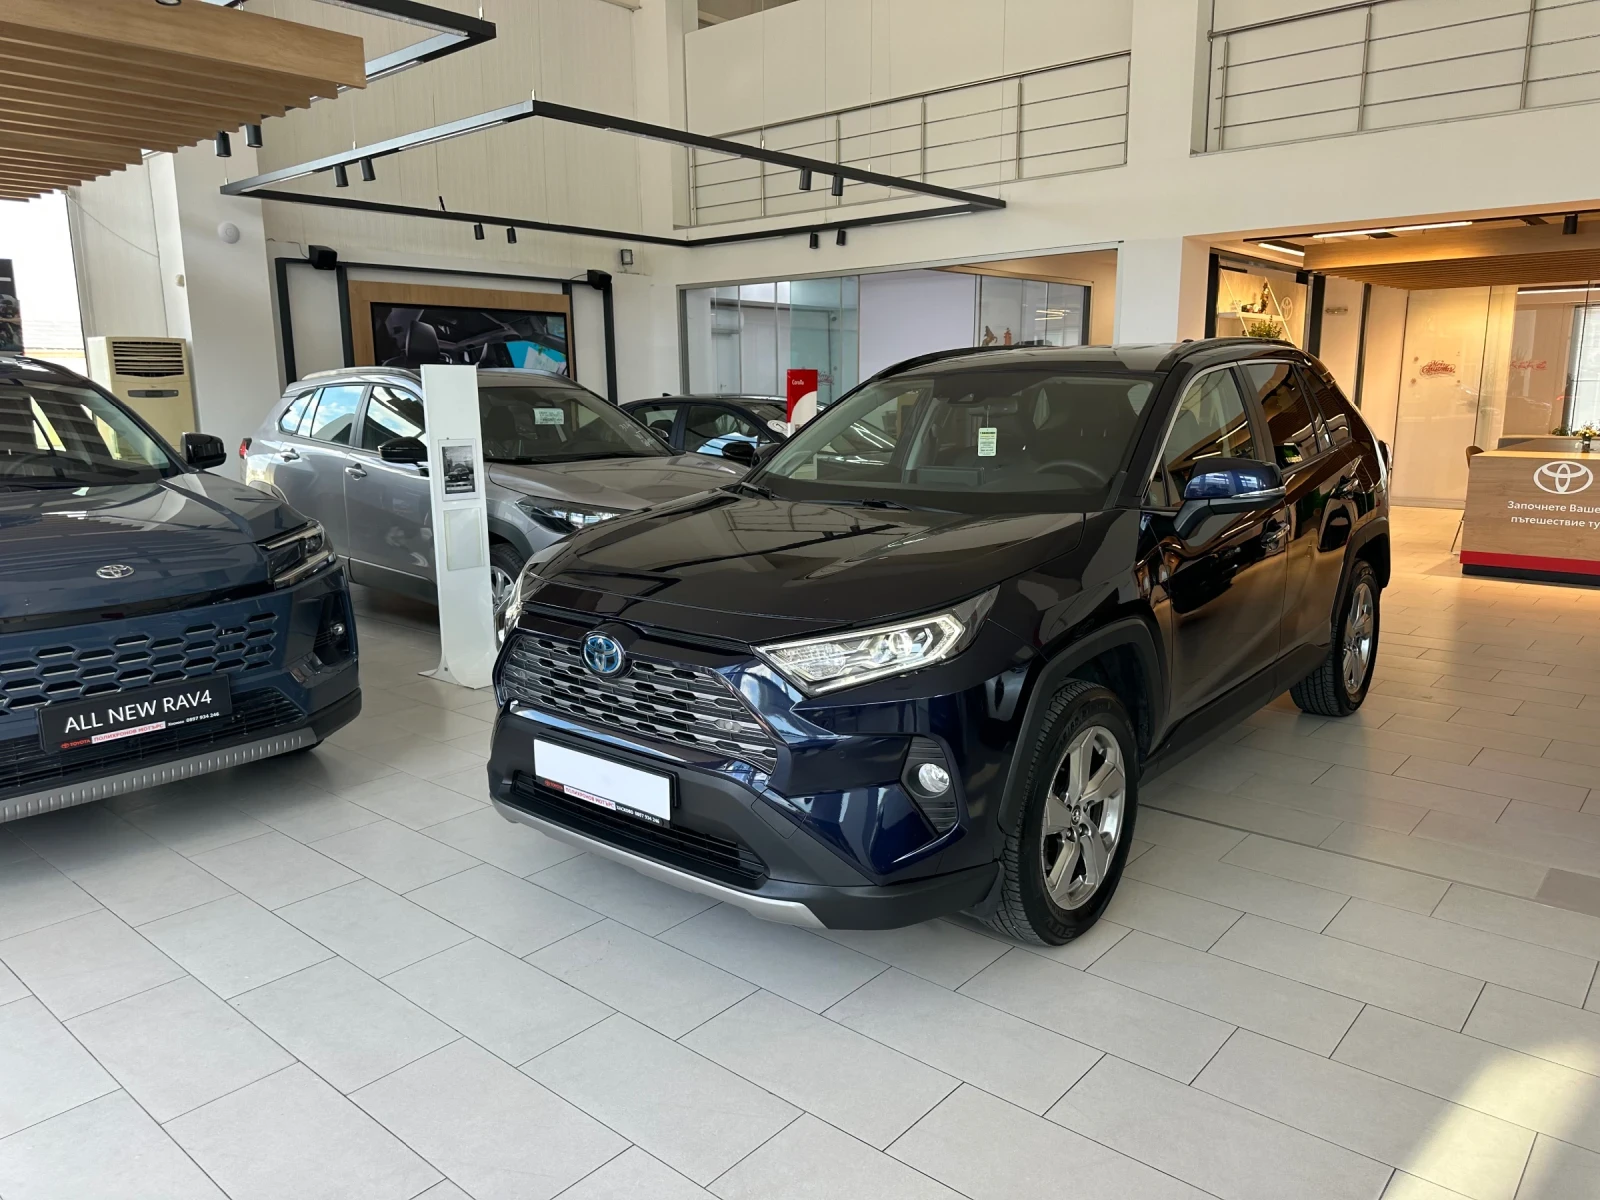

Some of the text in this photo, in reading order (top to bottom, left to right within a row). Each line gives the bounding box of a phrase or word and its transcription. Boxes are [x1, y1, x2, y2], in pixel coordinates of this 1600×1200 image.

[1507, 500, 1600, 514] Започнете Ваше
[1511, 516, 1586, 527] пътешествие
[64, 689, 212, 734] ALL NEW RAV4
[69, 738, 91, 748] TOYOTA
[93, 728, 138, 743] ПОЛИХРОНОВ
[138, 723, 165, 733] МОТЪРС
